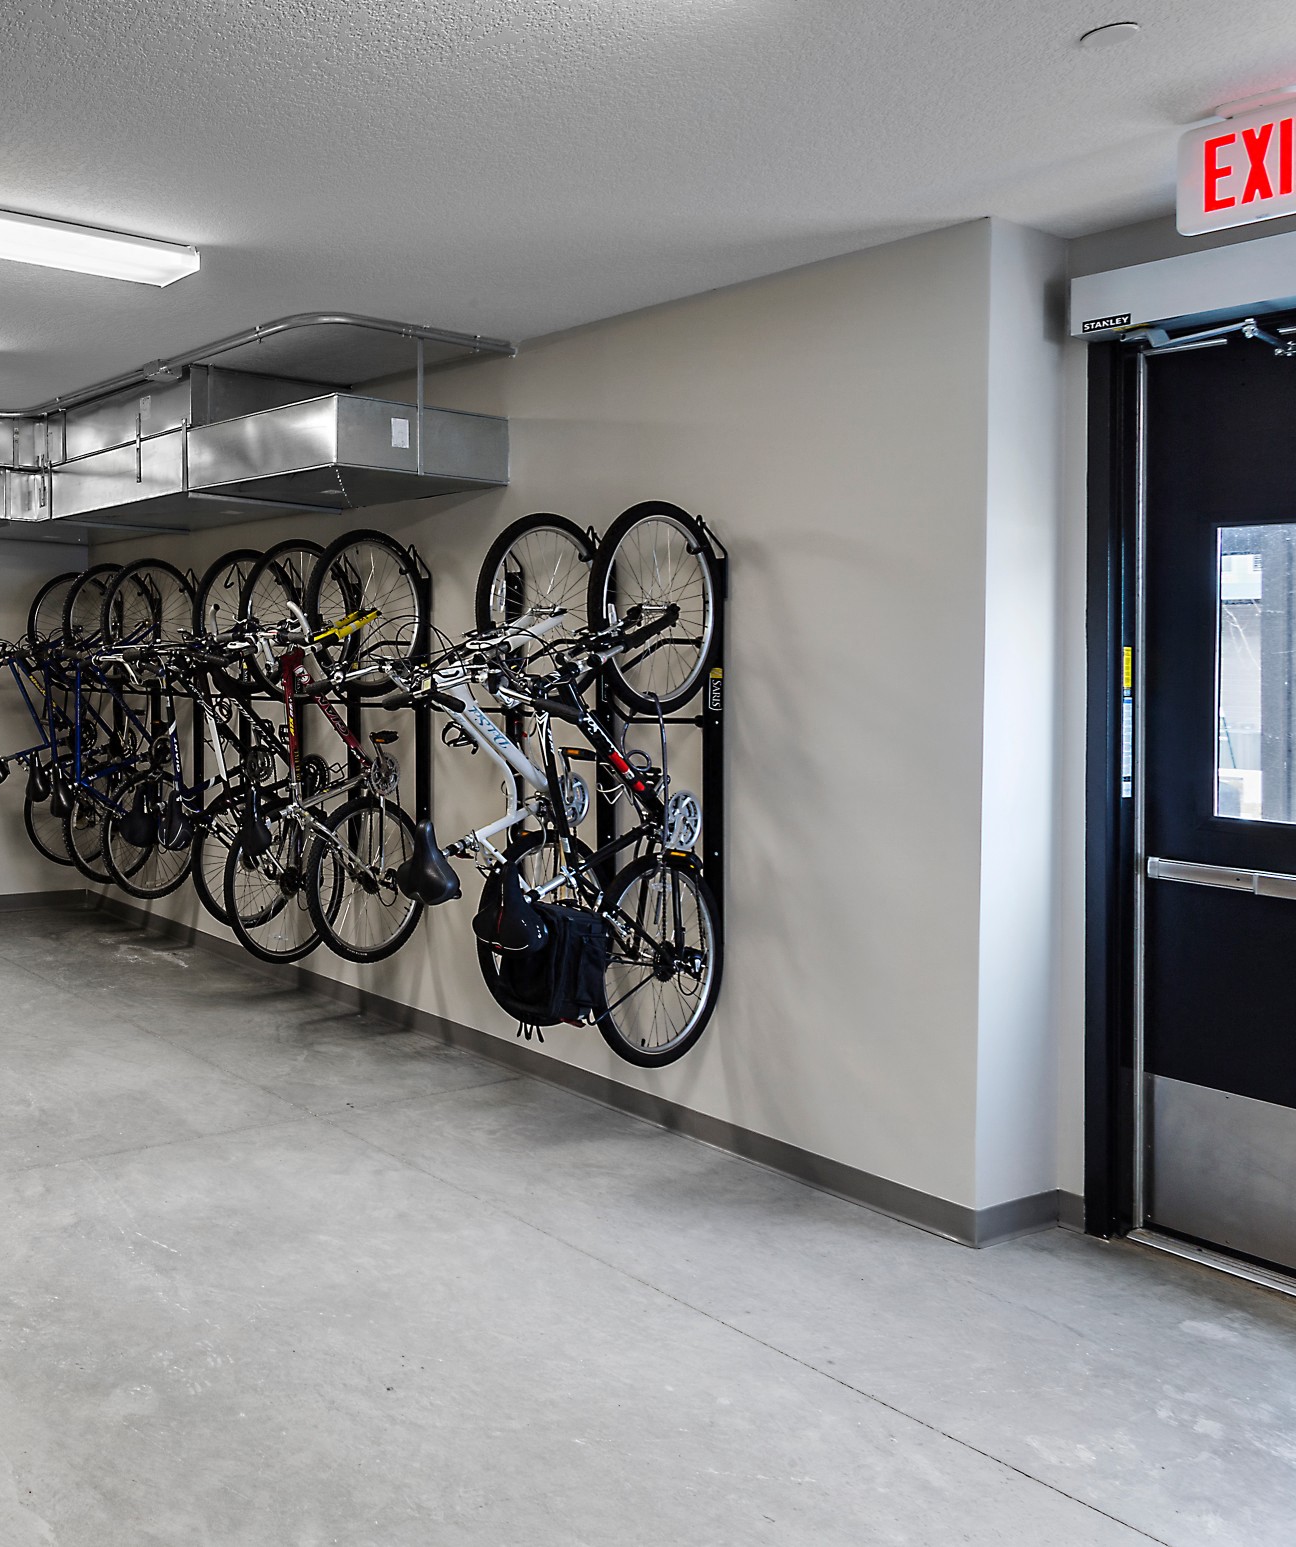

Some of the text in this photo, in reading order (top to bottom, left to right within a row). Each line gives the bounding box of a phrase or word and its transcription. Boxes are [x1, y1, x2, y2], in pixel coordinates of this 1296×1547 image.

[1204, 117, 1294, 213] EXI
[1083, 316, 1129, 331] STANLEY
[711, 679, 722, 708] SARIS
[314, 695, 350, 736] GIAN
[173, 737, 181, 773] GIANT
